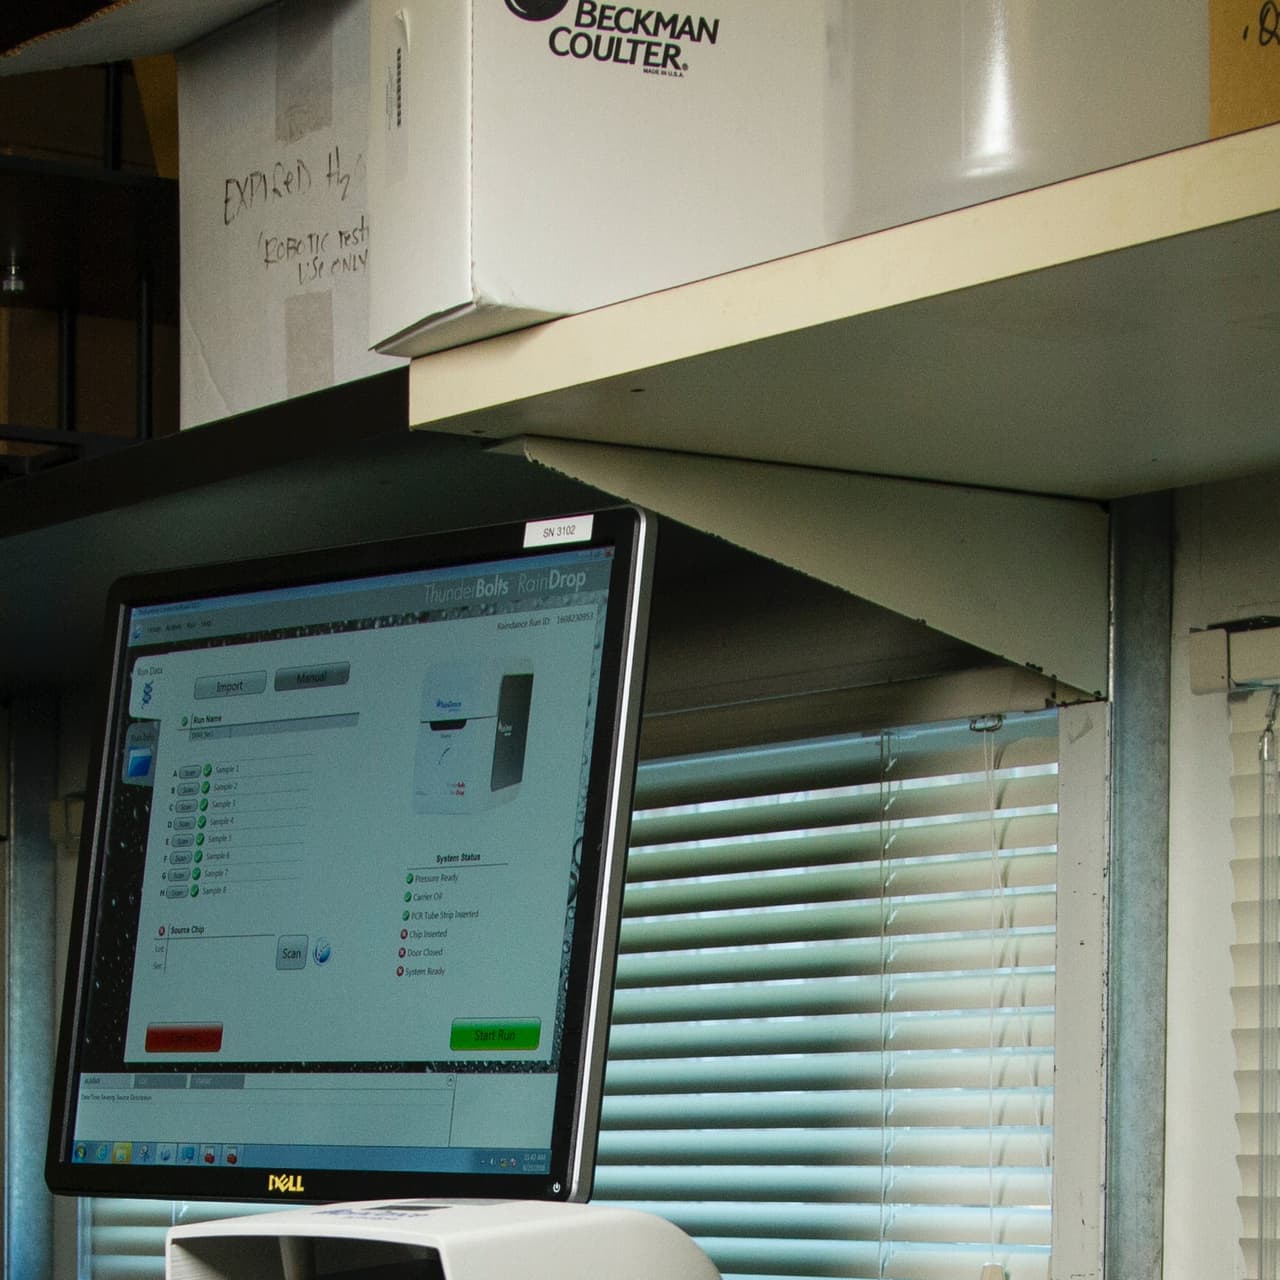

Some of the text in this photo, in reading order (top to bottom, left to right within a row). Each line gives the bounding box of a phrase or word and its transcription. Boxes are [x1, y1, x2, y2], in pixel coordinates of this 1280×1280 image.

[574, 0, 719, 44] BECKMAN
[543, 525, 576, 538] SN 3102
[297, 672, 327, 683] Manual
[216, 682, 243, 697] Import
[193, 714, 222, 724] Run Name
[436, 853, 480, 865] System Status
[441, 873, 458, 882] Ready
[171, 926, 190, 935] Source
[282, 948, 301, 960] Scan
[474, 1029, 516, 1041] Start Run
[268, 1174, 305, 1193] DELL
